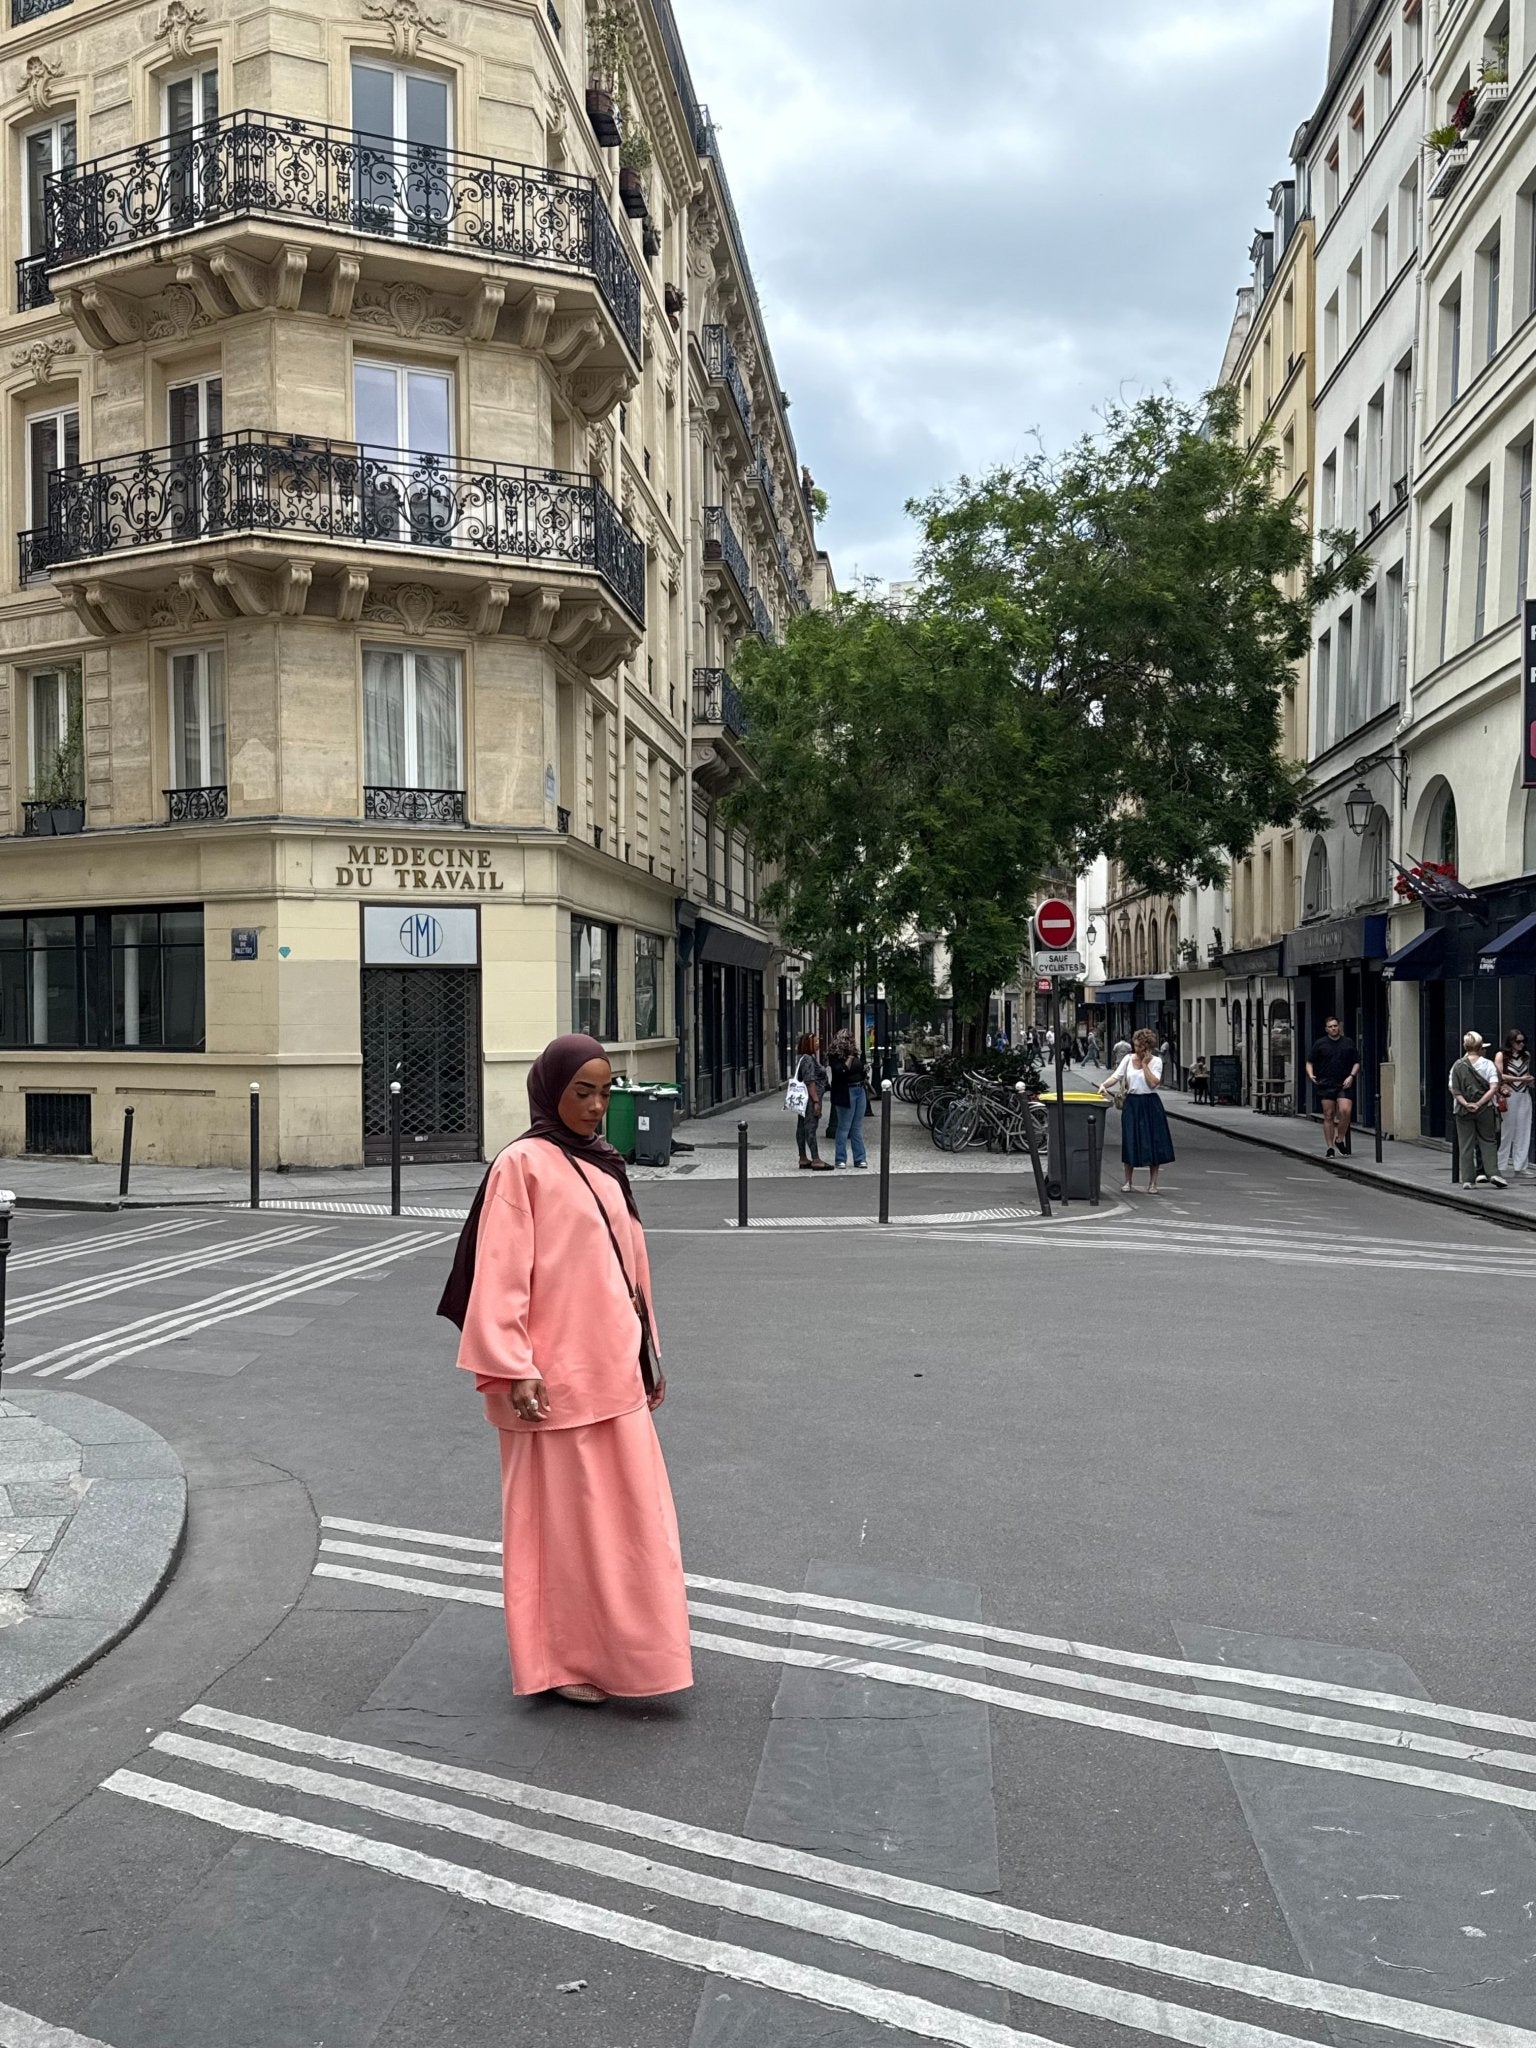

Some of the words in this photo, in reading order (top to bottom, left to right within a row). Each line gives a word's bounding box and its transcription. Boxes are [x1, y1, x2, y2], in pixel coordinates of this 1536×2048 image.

[348, 845, 492, 868] MEDECINE
[336, 867, 373, 886] DU
[395, 869, 504, 890] TRAVAIL
[400, 914, 441, 958] AMI
[1038, 963, 1079, 972] CYCLISTES
[1049, 954, 1068, 962] SAUF
